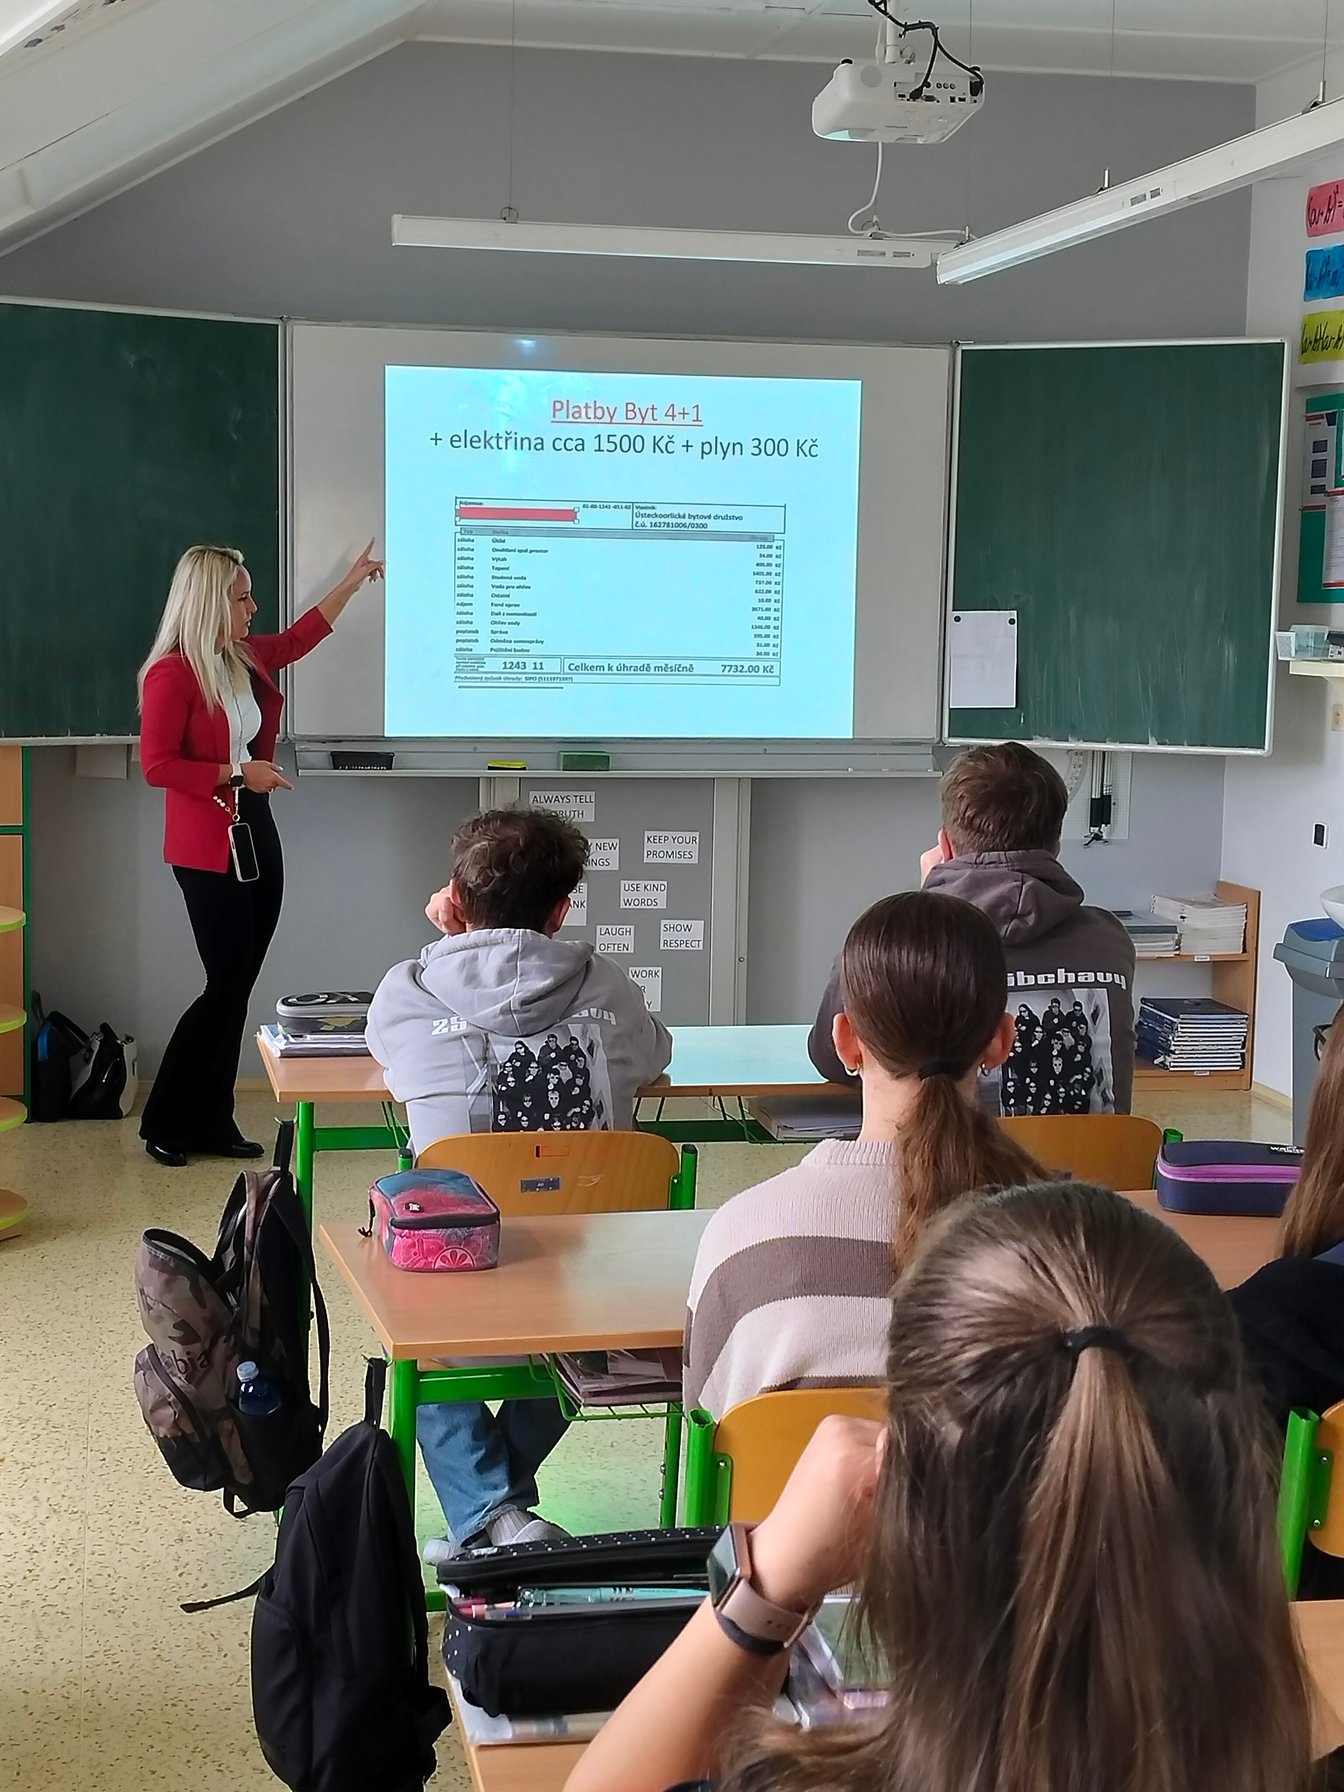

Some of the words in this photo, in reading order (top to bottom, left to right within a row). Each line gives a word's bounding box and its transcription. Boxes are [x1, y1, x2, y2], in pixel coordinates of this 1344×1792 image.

[550, 399, 618, 422] Platby
[625, 402, 658, 422] Byt
[664, 403, 702, 422] 4+1
[450, 429, 544, 451] elektřina
[552, 437, 584, 452] cca
[594, 434, 644, 453] 1500
[653, 435, 674, 454] Kč
[701, 436, 743, 460] plyn
[751, 437, 788, 457] 300
[796, 438, 818, 458] Kč
[502, 661, 526, 670] 1243
[532, 662, 544, 670] 11
[568, 662, 605, 672] Celkem
[607, 663, 614, 672] k
[616, 663, 651, 674] úhradě
[653, 663, 694, 674] měsíčně
[721, 664, 759, 675] 7732.00
[762, 665, 774, 674] Kč
[531, 794, 571, 805] ALWAYS
[572, 794, 594, 804] TELL
[646, 835, 669, 844] KEEP
[671, 835, 697, 844] YOUR
[595, 842, 618, 851] NEW
[646, 850, 693, 860] PROMISES
[623, 883, 641, 892] USE
[643, 883, 666, 892] KIND
[623, 898, 658, 906] WORDS
[599, 927, 632, 936] LAUGH
[663, 923, 692, 932] SHOW
[598, 942, 629, 953] OFTEN
[662, 939, 702, 950] RESPECT
[630, 969, 660, 979] WORK
